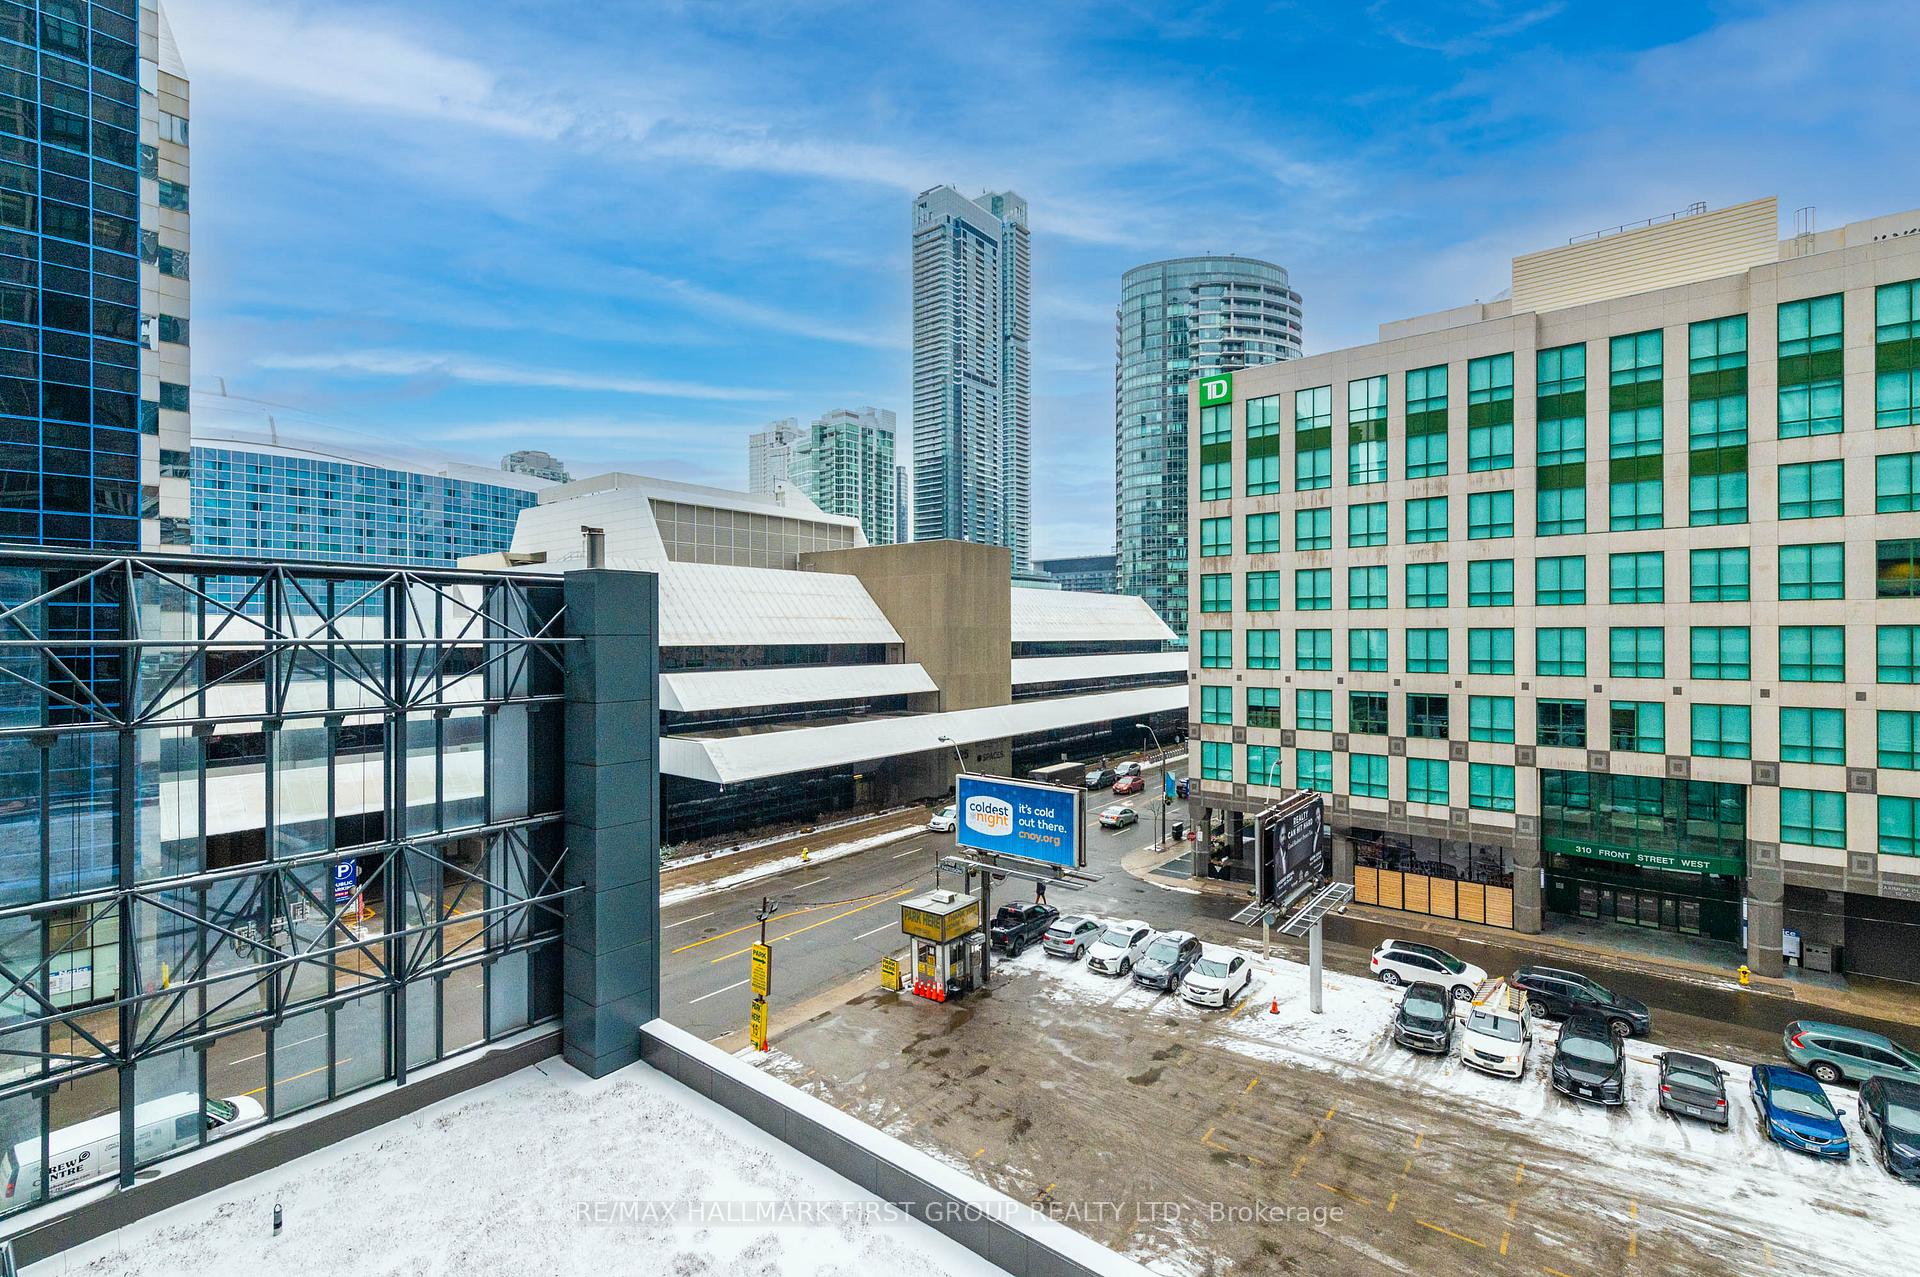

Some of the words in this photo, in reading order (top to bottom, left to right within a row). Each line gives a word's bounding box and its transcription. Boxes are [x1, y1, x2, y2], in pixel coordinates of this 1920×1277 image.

[1202, 379, 1228, 400] TD
[969, 801, 1009, 817] coldest
[1034, 807, 1055, 818] cold
[976, 812, 1009, 828] night
[1018, 819, 1035, 828] out
[1037, 819, 1067, 834] there.
[1575, 845, 1592, 854] 310
[1598, 849, 1631, 860] FRONT
[1637, 854, 1675, 865] STREET
[1680, 859, 1711, 869] WEST
[49, 1159, 77, 1175] REW
